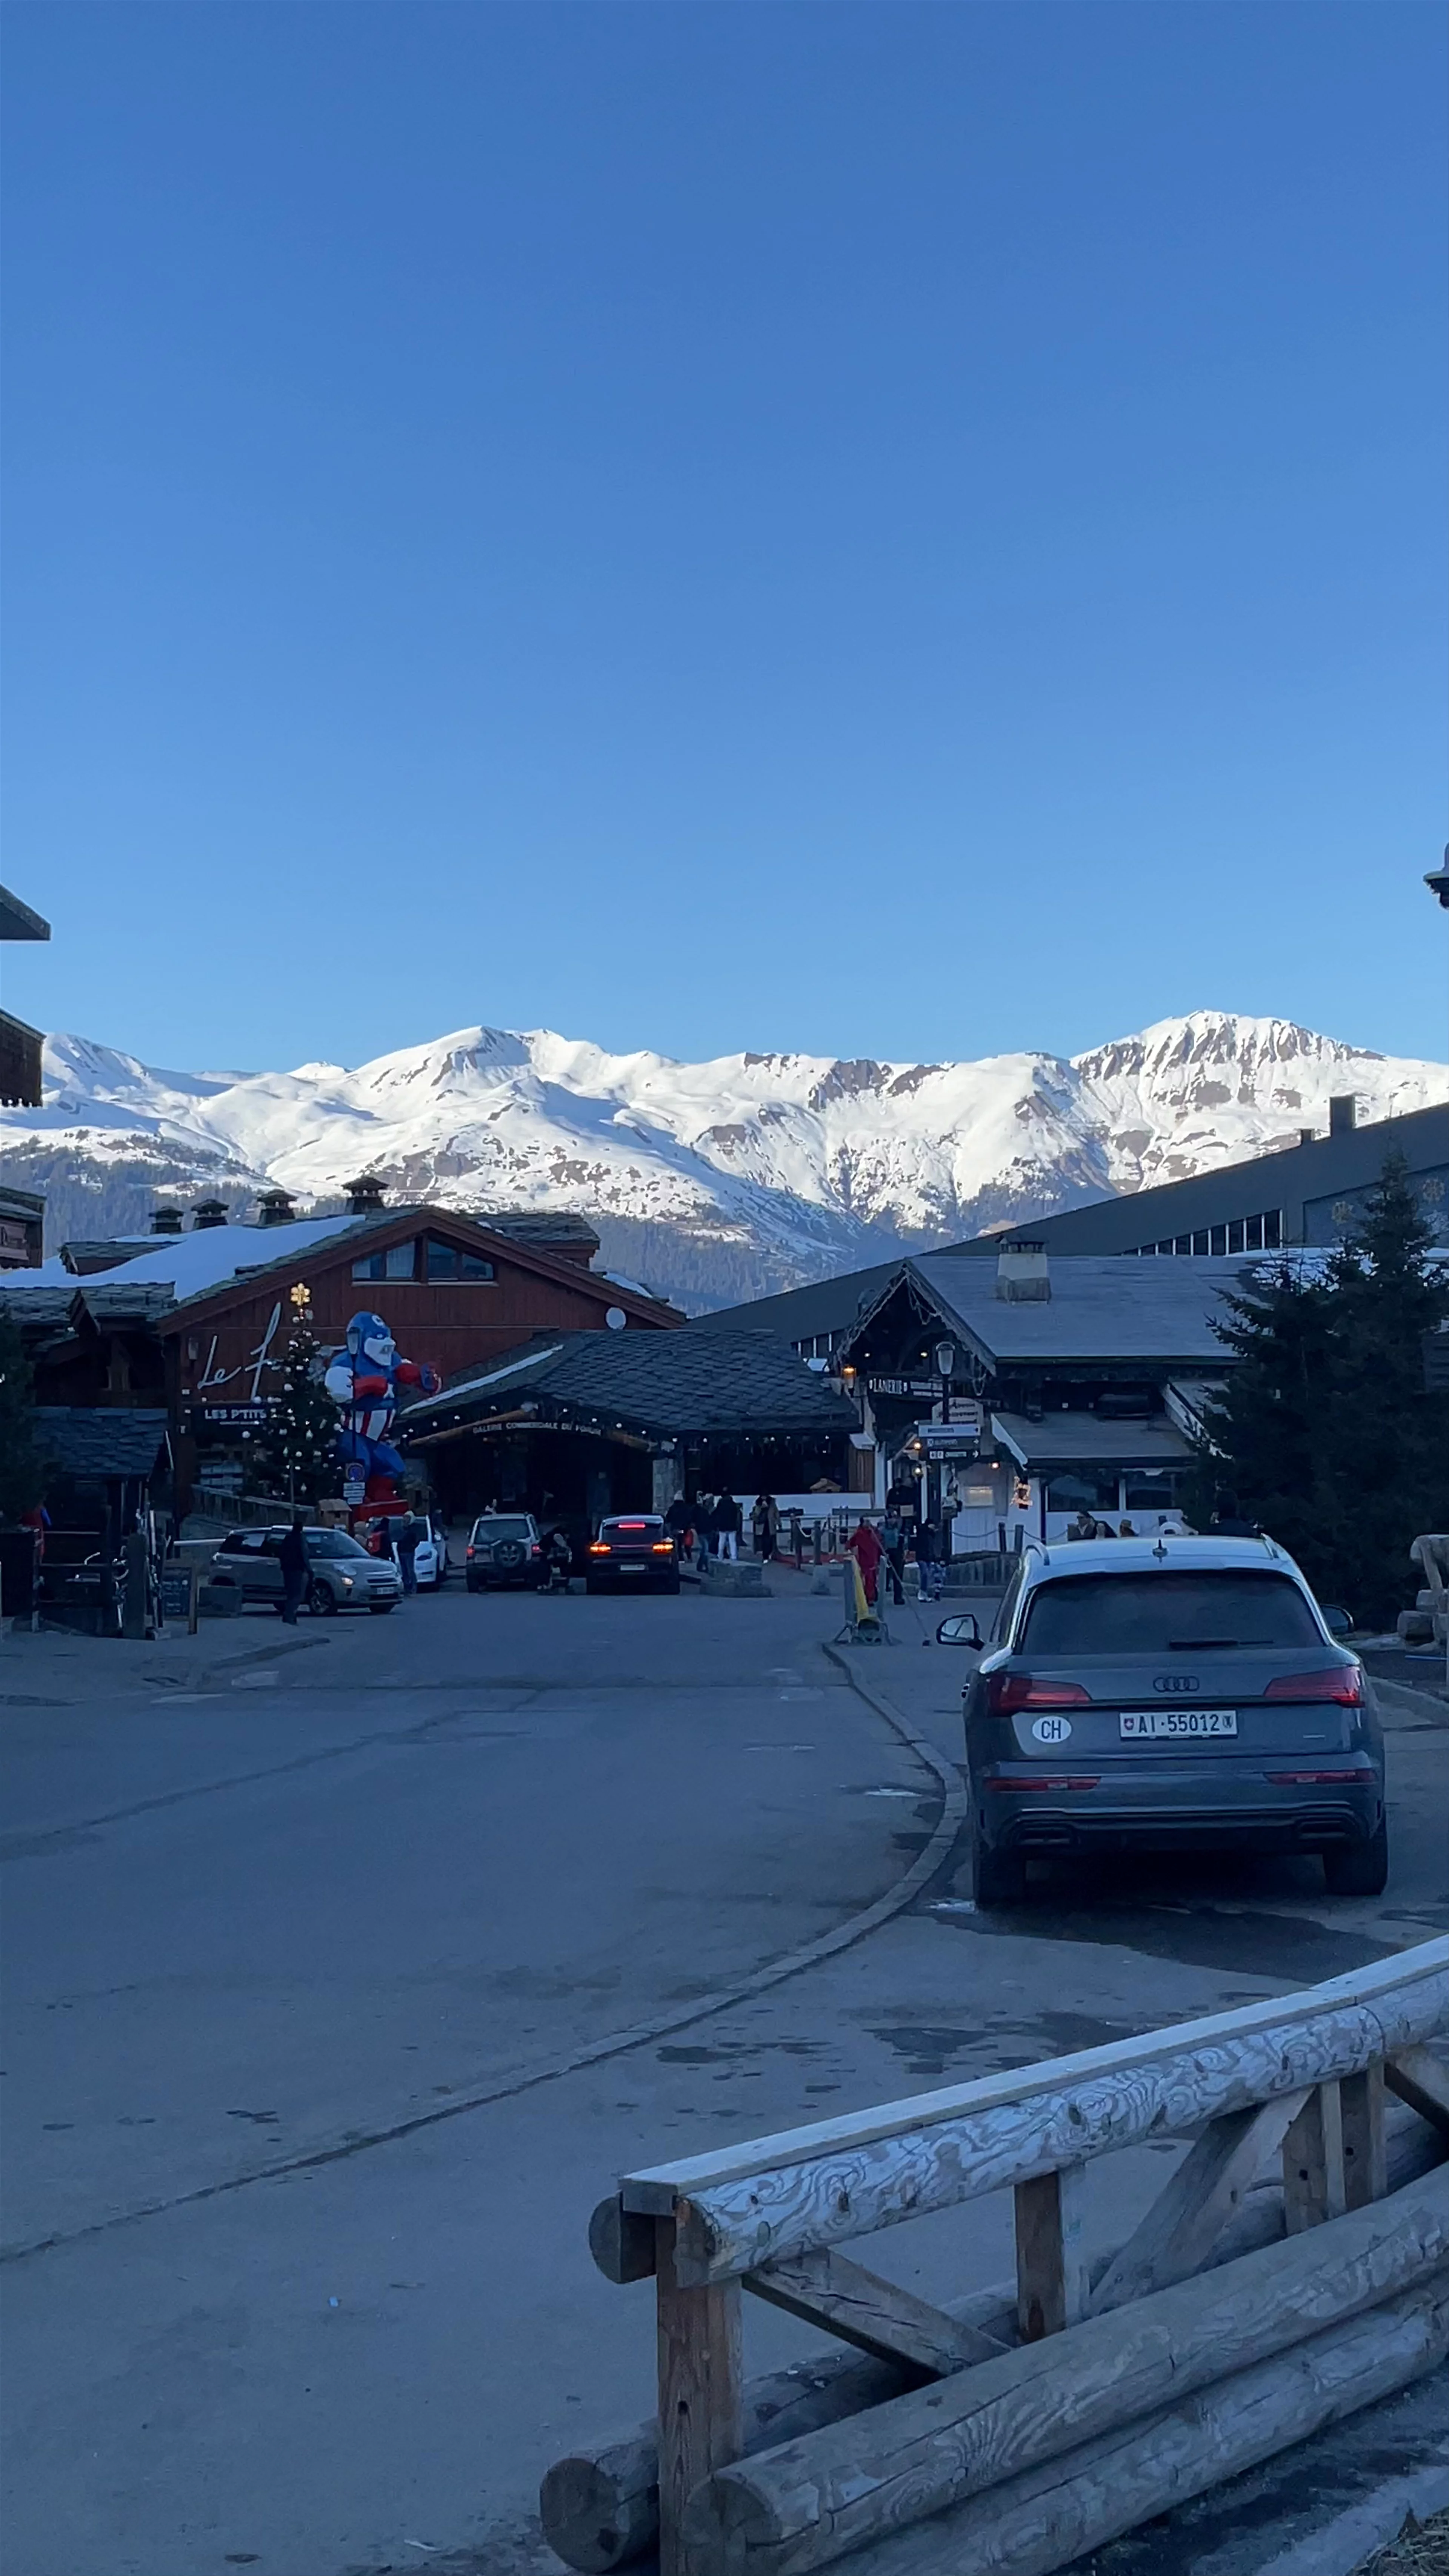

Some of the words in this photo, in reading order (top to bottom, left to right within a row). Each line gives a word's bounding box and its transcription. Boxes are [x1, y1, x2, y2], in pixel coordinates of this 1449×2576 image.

[197, 1335, 242, 1390] Le
[205, 1409, 227, 1419] LES
[1041, 1720, 1061, 1739] CH
